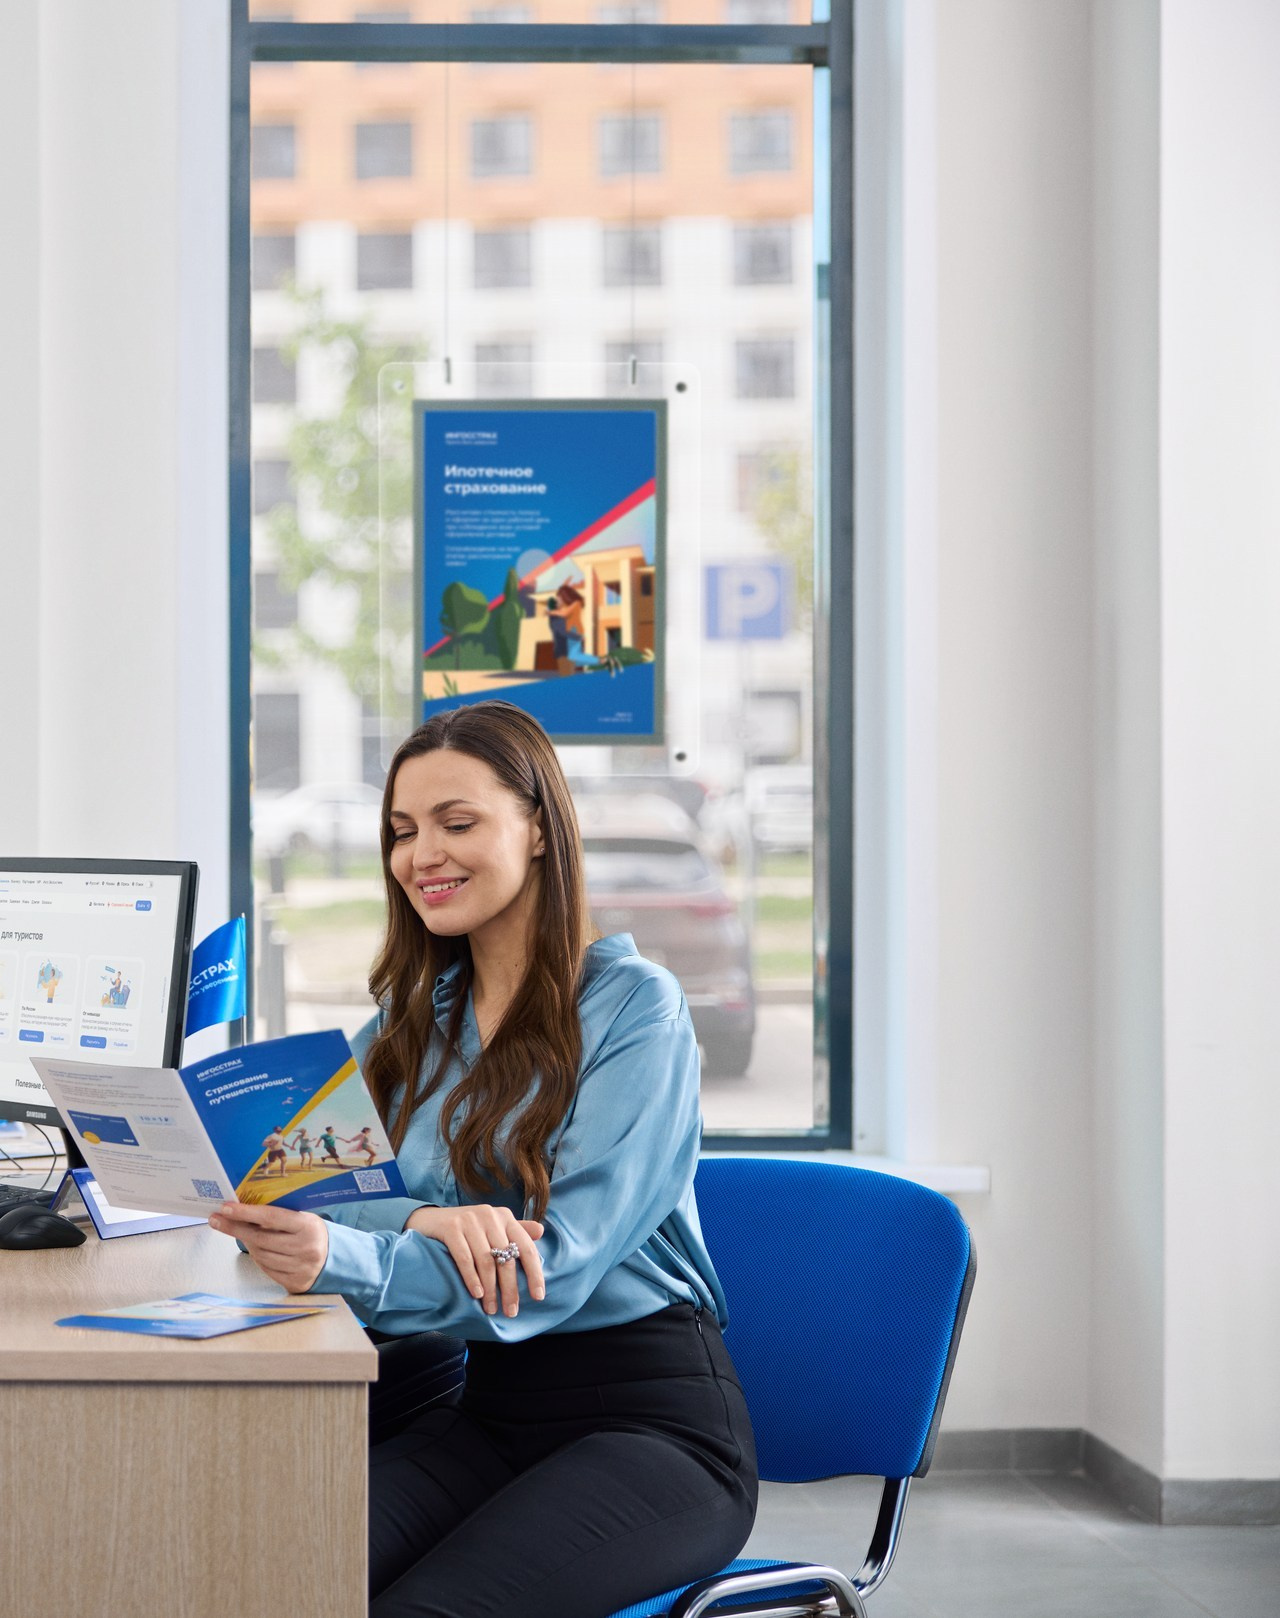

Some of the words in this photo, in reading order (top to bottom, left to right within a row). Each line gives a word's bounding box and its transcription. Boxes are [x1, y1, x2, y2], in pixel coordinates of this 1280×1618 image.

[444, 465, 534, 479] Ипотечное
[444, 483, 547, 498] страхование
[1, 931, 13, 939] для
[14, 931, 44, 941] туристов
[196, 1058, 242, 1079] ИНГОССТРАХ
[15, 1079, 42, 1090] Полезные
[205, 1072, 269, 1097] Страхование
[208, 1077, 294, 1106] путешествующих
